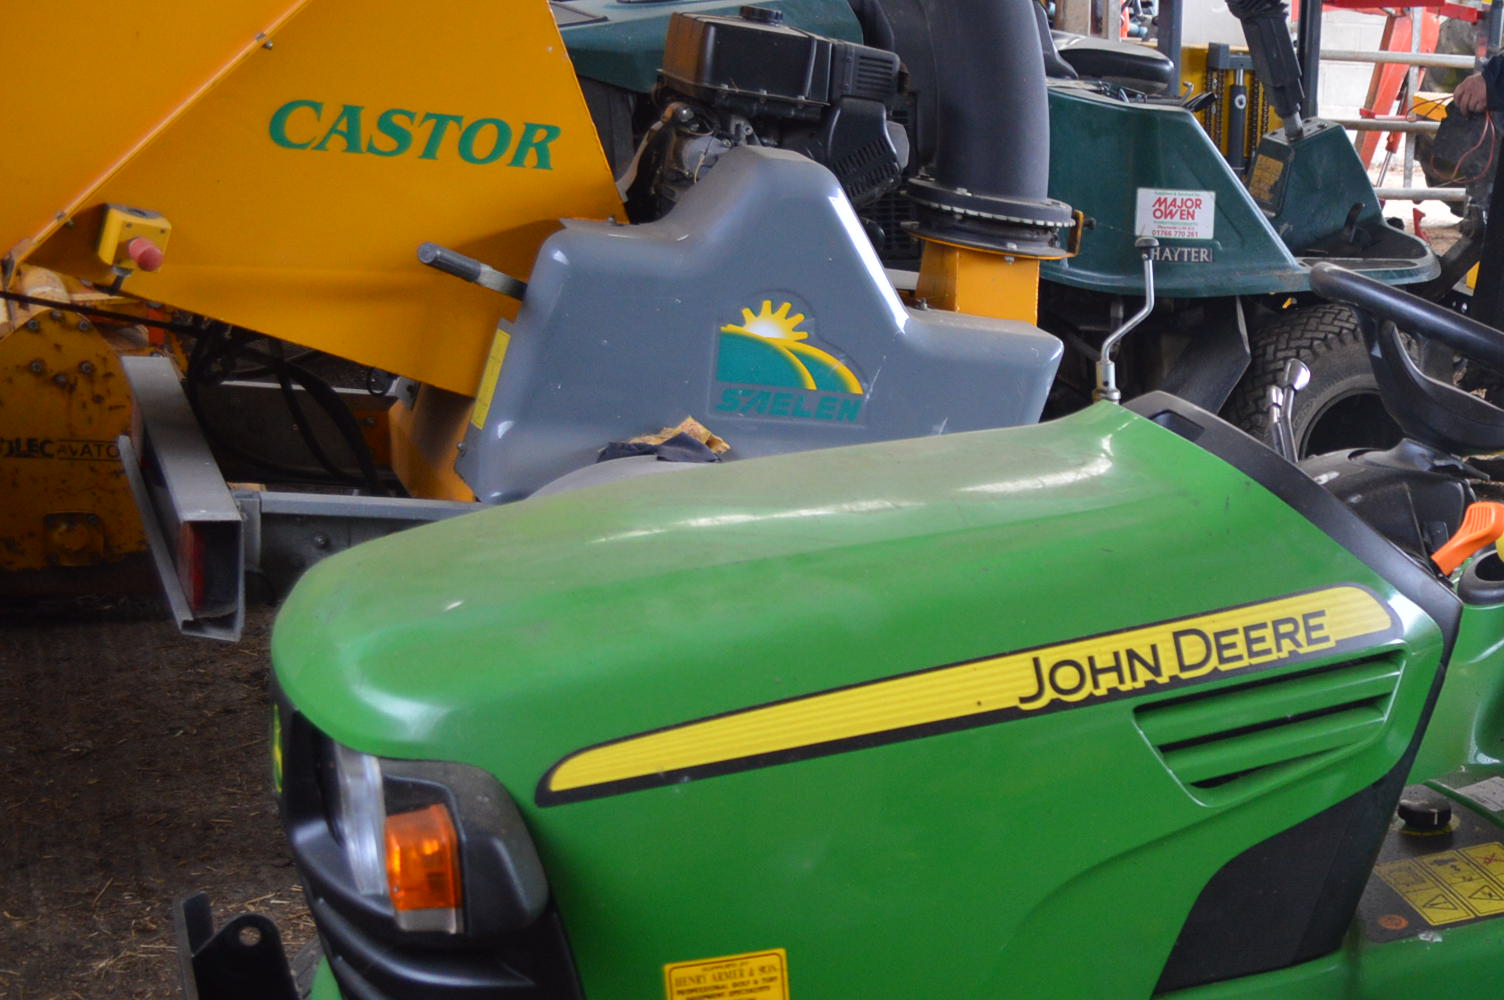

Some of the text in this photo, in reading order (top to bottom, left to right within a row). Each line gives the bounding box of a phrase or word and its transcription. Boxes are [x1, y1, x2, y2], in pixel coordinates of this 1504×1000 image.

[268, 98, 562, 171] CASTOR
[1152, 196, 1203, 210] MAJOR
[1152, 207, 1196, 220] OWEN
[1018, 609, 1332, 704] JOHN DEERE
